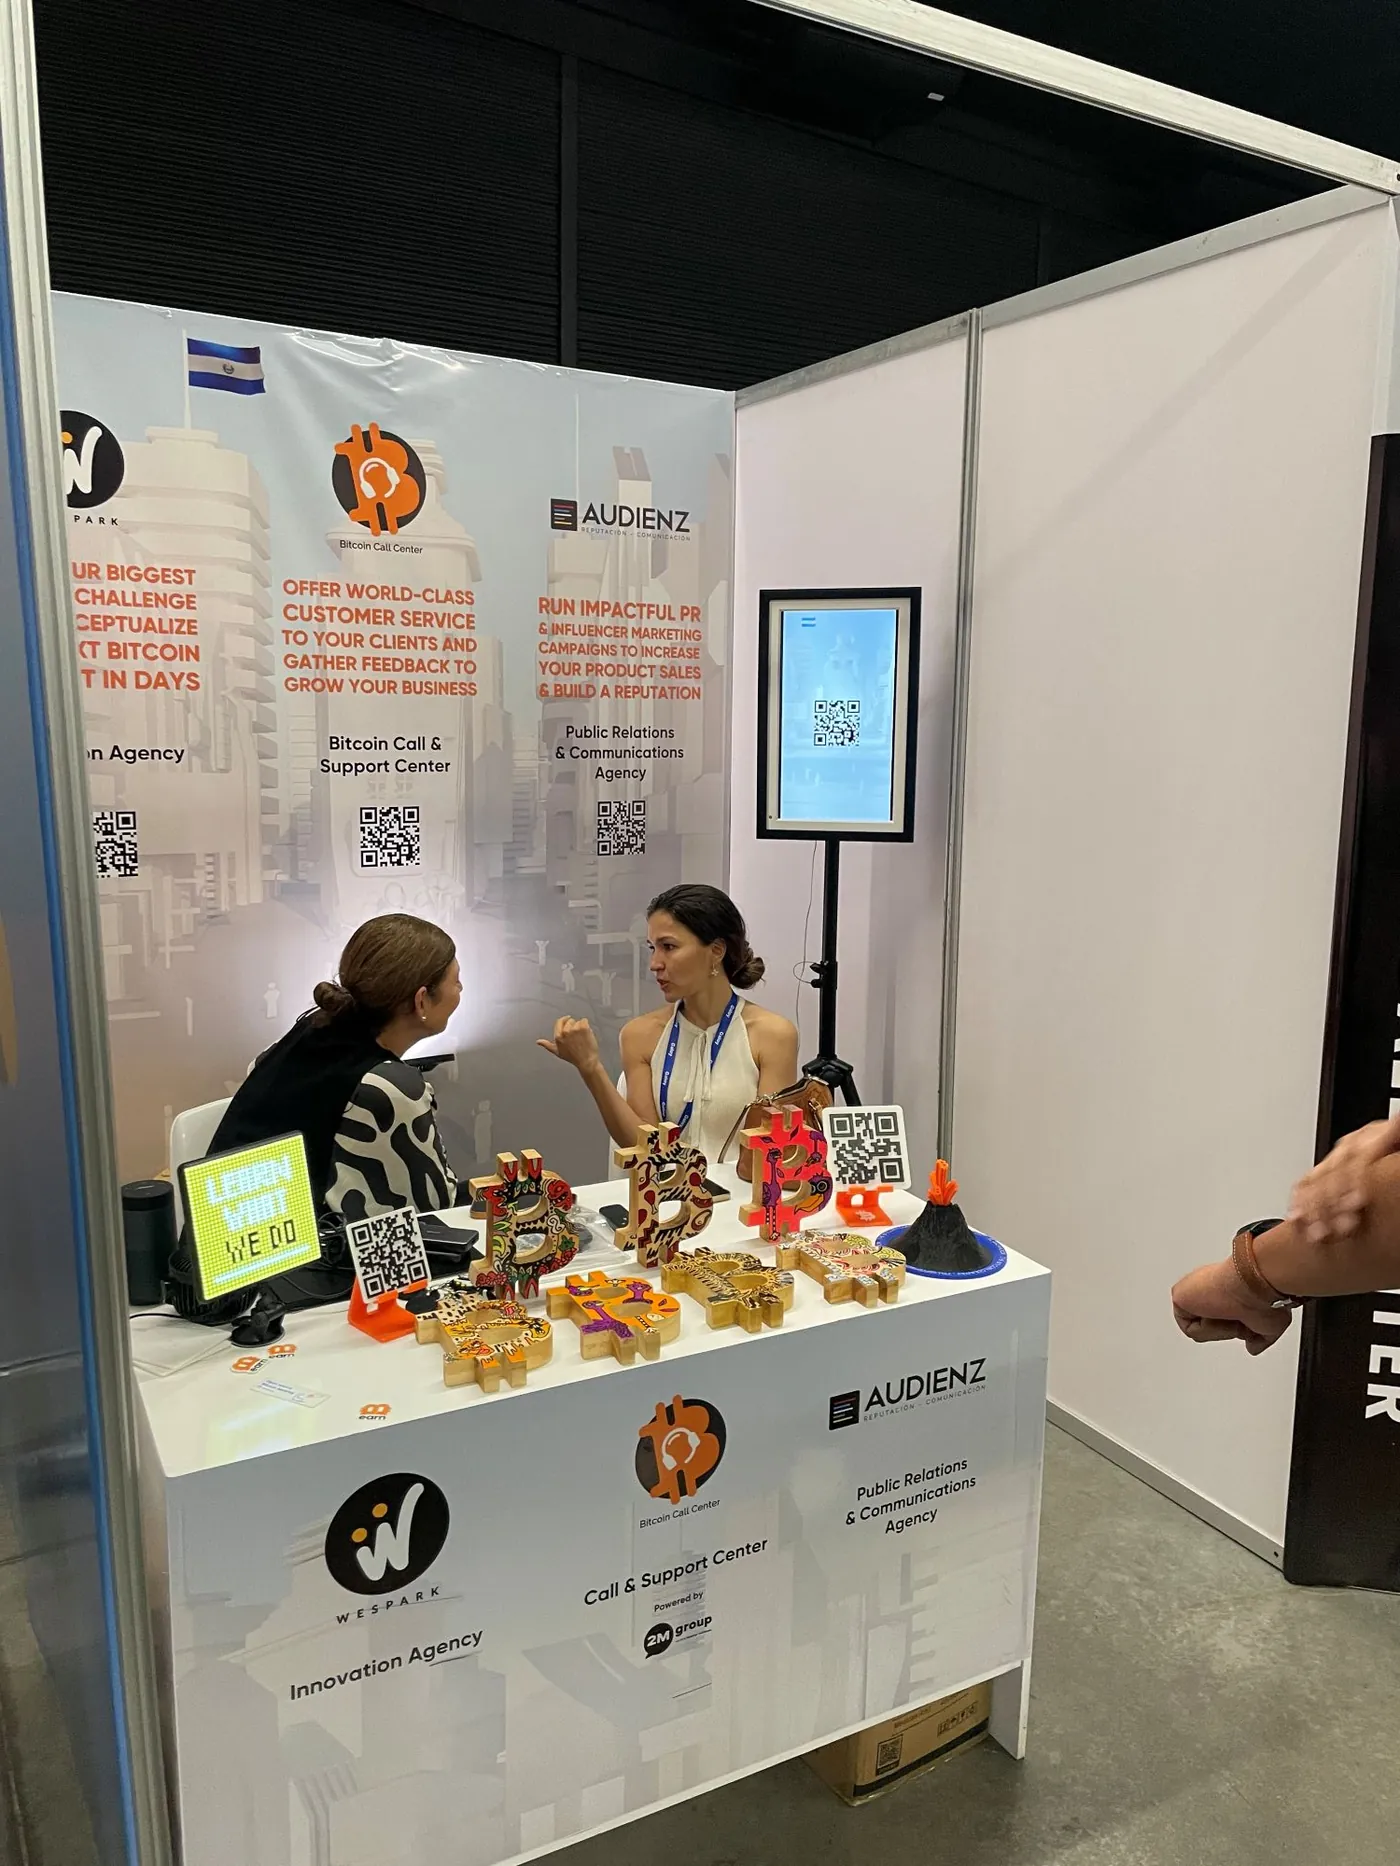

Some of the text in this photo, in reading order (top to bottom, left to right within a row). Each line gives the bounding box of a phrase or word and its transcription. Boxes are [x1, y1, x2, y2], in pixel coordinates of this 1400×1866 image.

[582, 502, 690, 533] AUDIENZ
[340, 539, 423, 554] Bitcoin Call Center
[107, 564, 196, 585] BIGGEST
[74, 588, 197, 610] CHALLENGE
[283, 579, 475, 606] OFFER WORLD-CLASS
[283, 603, 476, 630] CUSTOMER SERVICE
[538, 597, 702, 622] RUN IMPACTFUL PR
[281, 630, 477, 653] TO YOUR CLIENTS AND
[538, 622, 702, 641] & INFLUENCER MARKETING
[107, 641, 200, 662] BITCOIN
[538, 641, 700, 659] CAMPAIGNS TO INCREASE
[283, 653, 477, 675] GATHER FEEDBACK TO
[538, 661, 702, 680] YOUR PRODUCT SALES
[103, 669, 127, 689] IN
[134, 671, 200, 691] DAYS
[284, 677, 477, 697] GROW YOUR BUSINESS
[538, 683, 701, 700] & BUILD A REPUTATION
[566, 725, 675, 738] Public Relations
[109, 745, 185, 764] Agency
[329, 736, 441, 751] Bitcoin Call &
[555, 746, 684, 759] & Communications
[320, 759, 451, 776] Support Center
[595, 766, 646, 782] Agency
[226, 1219, 296, 1264] WE DO
[864, 1358, 986, 1412] AUDIENZ
[857, 1459, 968, 1501] Public Relations
[846, 1477, 976, 1525] & Communications
[640, 1499, 720, 1529] Bitcoin Call Center
[885, 1508, 938, 1534] Agency
[584, 1539, 768, 1605] Call & Support Center
[336, 1587, 440, 1624] WESPARK
[654, 1592, 704, 1612] Powered by
[647, 1630, 670, 1647] 2M
[675, 1616, 712, 1637] group
[290, 1631, 483, 1700] Innovation Agency
